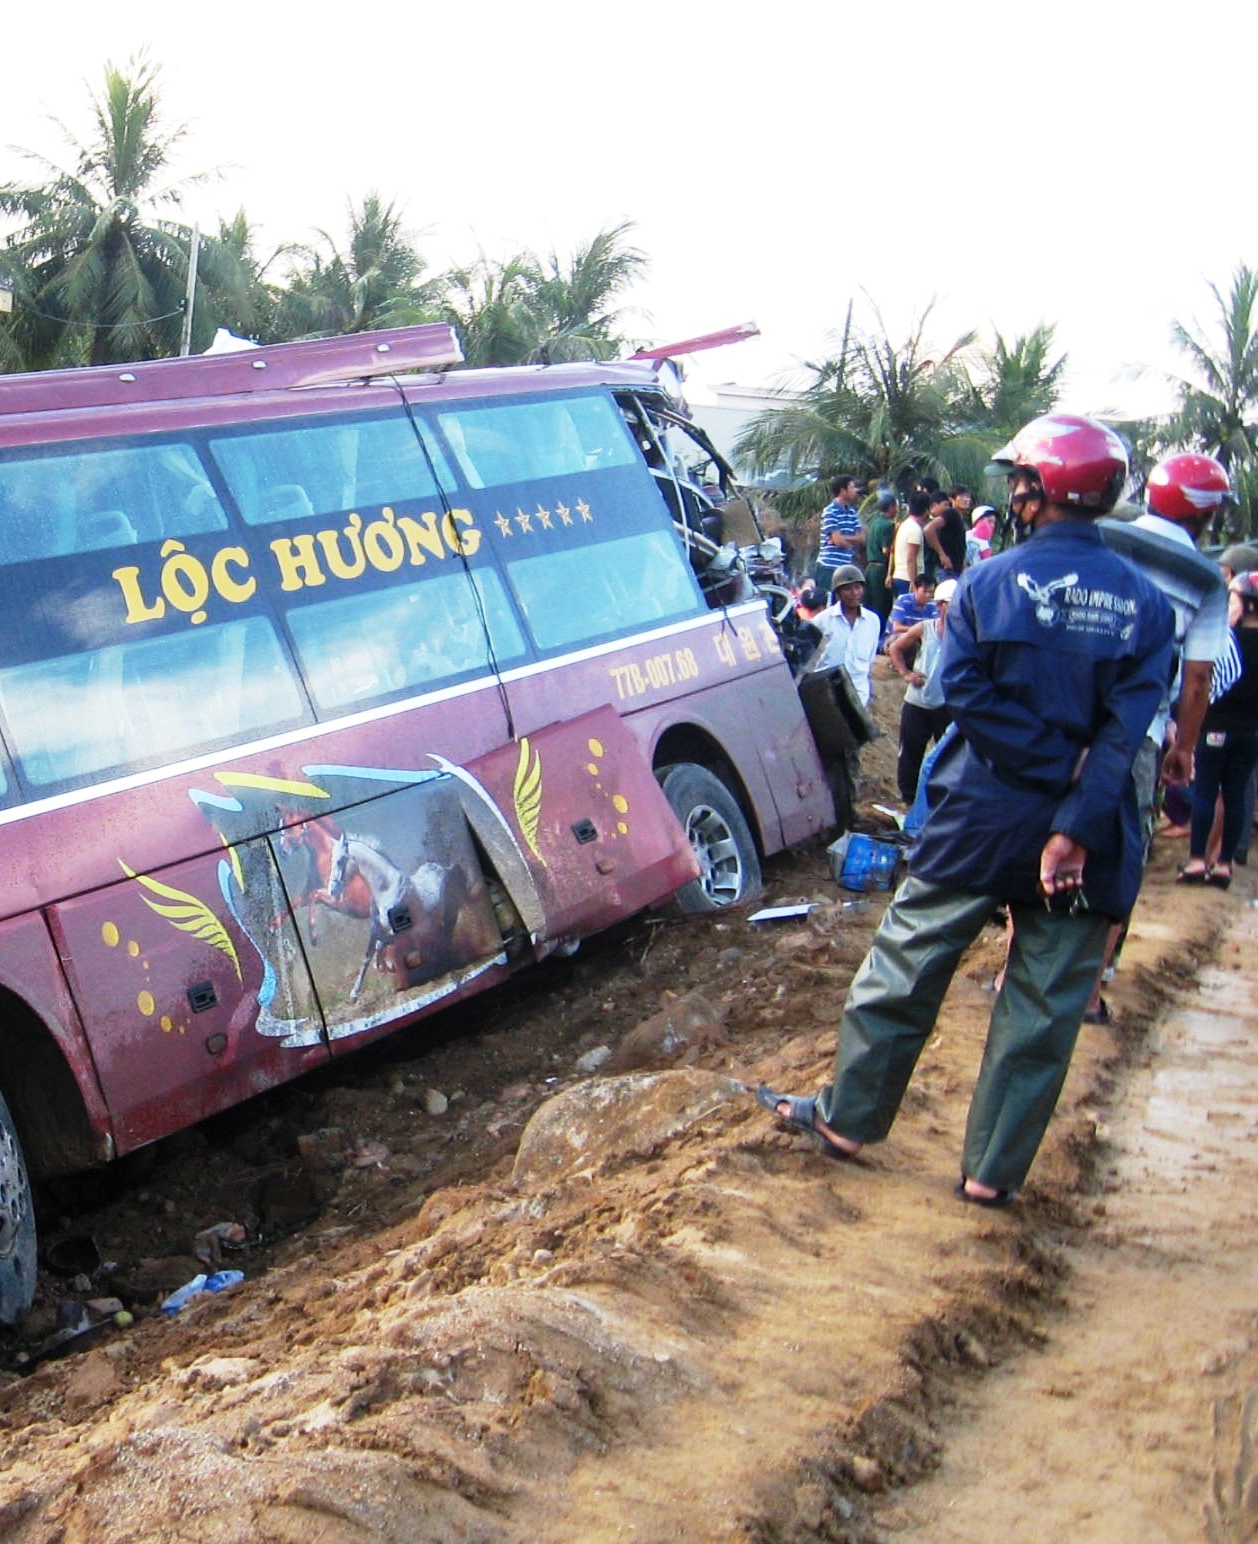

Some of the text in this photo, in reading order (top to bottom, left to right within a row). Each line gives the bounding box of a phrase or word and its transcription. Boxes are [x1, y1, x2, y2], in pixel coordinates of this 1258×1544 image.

[112, 506, 483, 625] LỘC HƯƠNG
[609, 648, 699, 699] 77B-007.68
